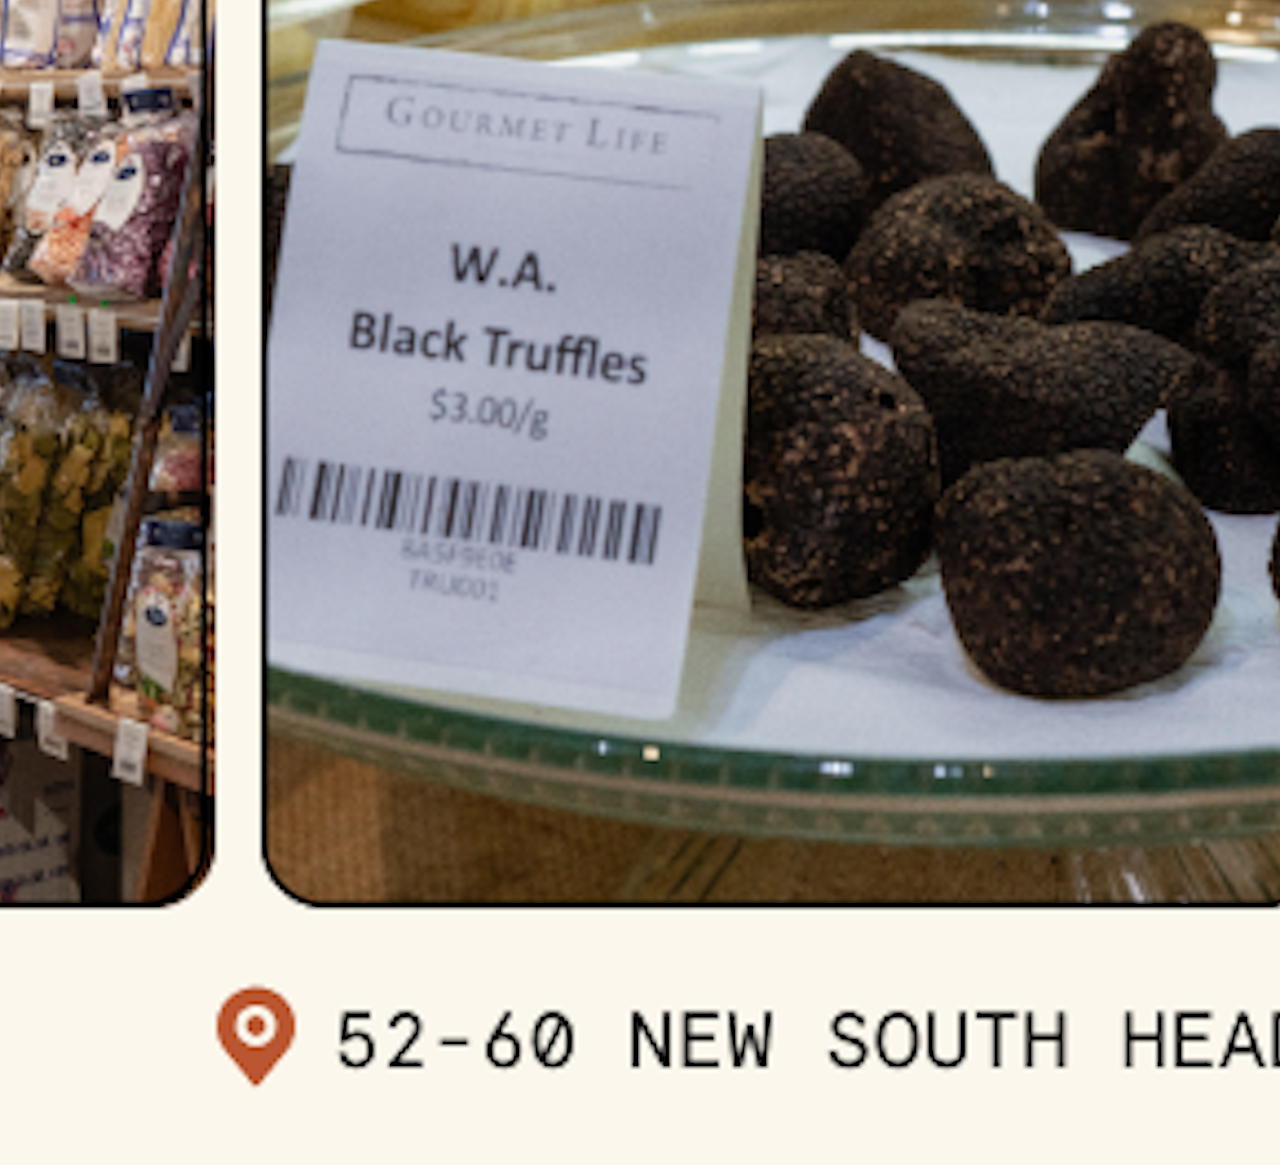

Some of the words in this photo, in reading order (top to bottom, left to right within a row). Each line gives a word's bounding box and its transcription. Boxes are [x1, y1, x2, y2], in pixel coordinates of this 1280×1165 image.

[450, 242, 557, 293] W.A.
[350, 311, 468, 363] Black
[484, 327, 648, 386] Truffles
[429, 388, 550, 441] $3.00/g
